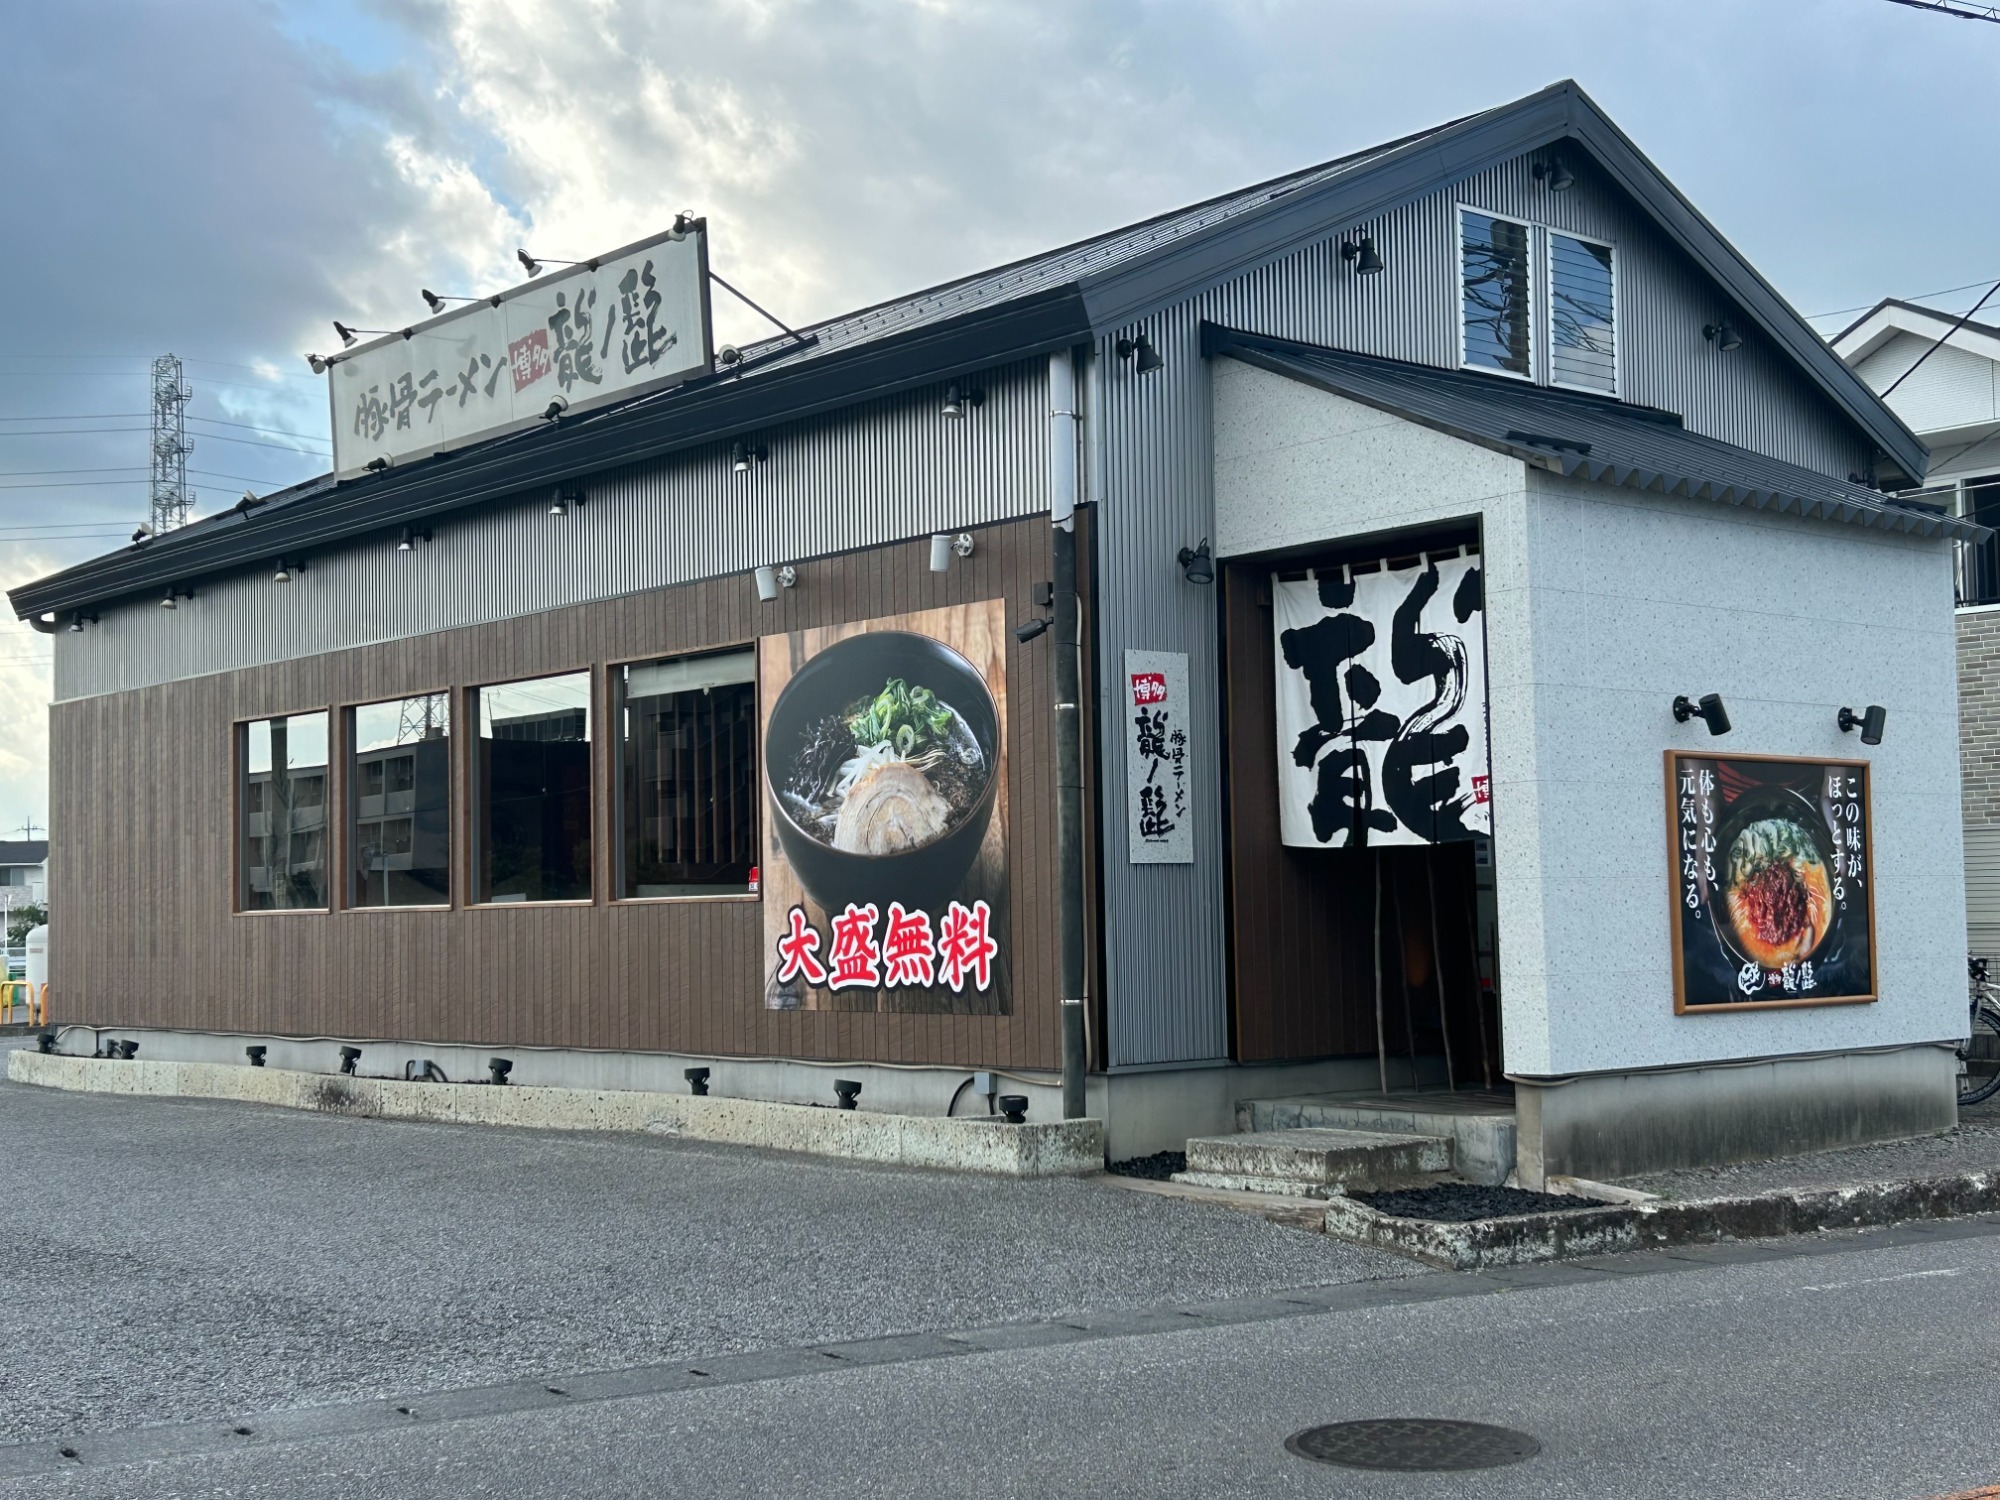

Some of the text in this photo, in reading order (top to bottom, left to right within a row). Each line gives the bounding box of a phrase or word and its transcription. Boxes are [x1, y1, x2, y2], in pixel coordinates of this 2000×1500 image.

[354, 353, 507, 441] 豚骨ラーメン
[511, 338, 550, 381] 博多
[1133, 676, 1166, 700] 博多
[1170, 728, 1188, 818] 豚骨ラーメン
[1680, 768, 1701, 919] 元気になる。
[1699, 769, 1719, 892] 体も心も、
[1828, 775, 1847, 910] ほっとする。
[1845, 777, 1863, 888] この味が、
[778, 901, 998, 993] 大盛無料
